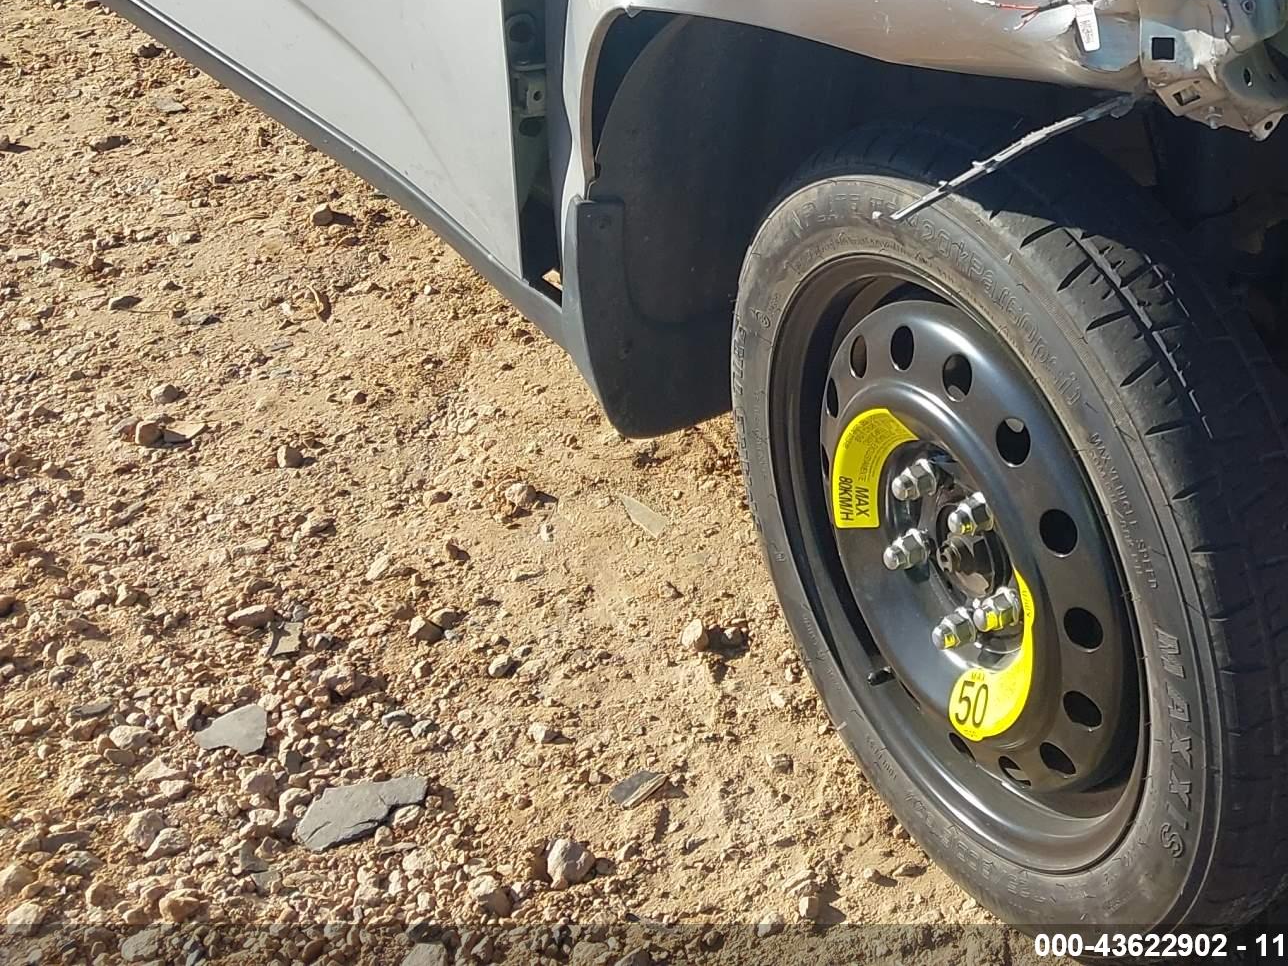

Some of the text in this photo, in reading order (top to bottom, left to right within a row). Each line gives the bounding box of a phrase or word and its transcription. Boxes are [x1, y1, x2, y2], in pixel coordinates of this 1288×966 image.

[838, 475, 854, 522] 80KM/H
[855, 485, 871, 518] MAX
[970, 672, 986, 682] MAX
[954, 680, 989, 729] 50
[1154, 626, 1194, 860] MAXXIS
